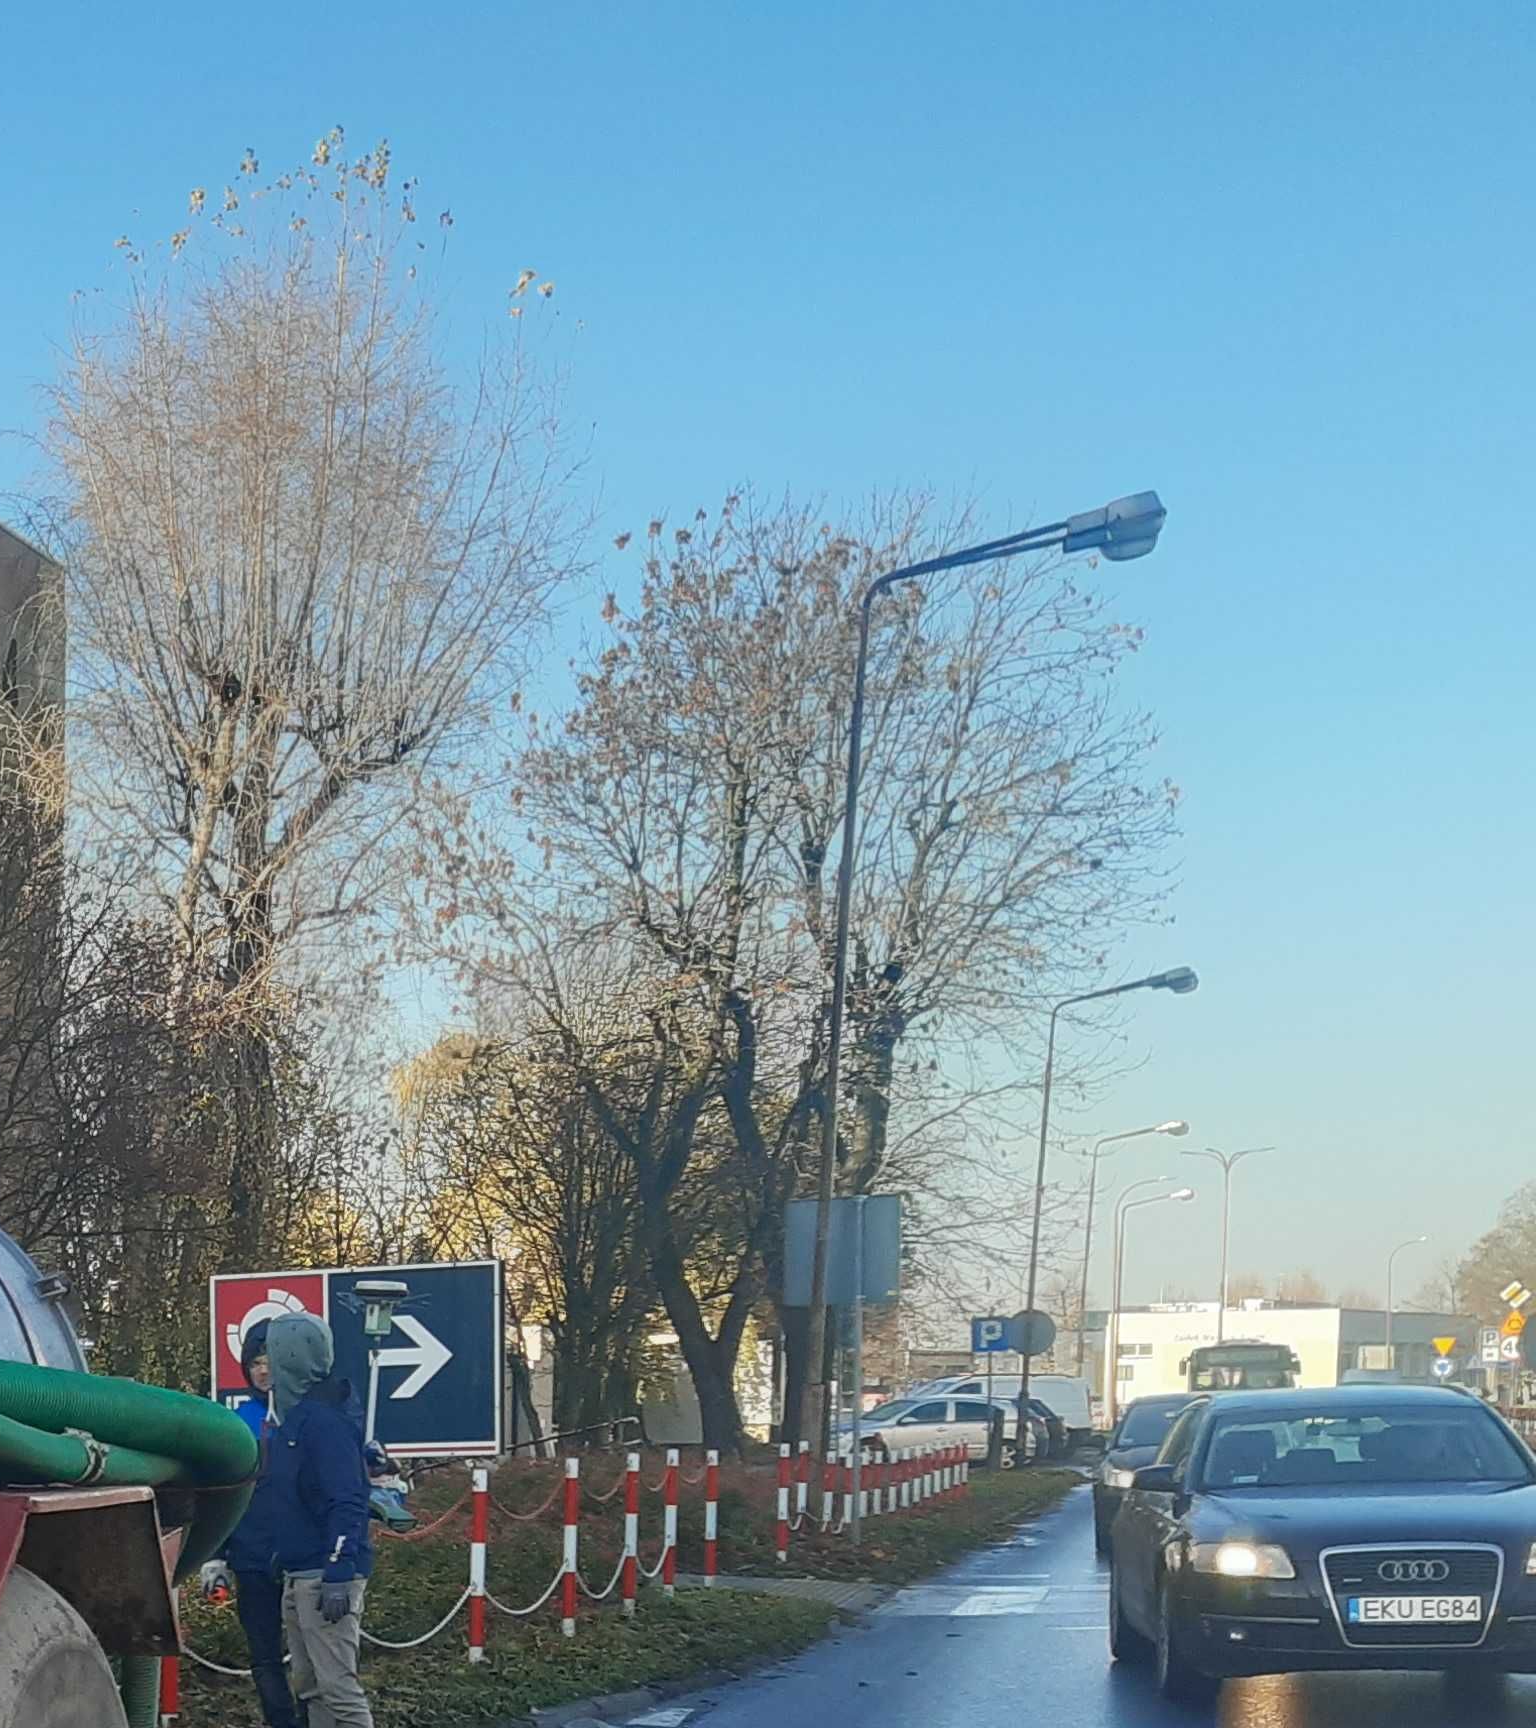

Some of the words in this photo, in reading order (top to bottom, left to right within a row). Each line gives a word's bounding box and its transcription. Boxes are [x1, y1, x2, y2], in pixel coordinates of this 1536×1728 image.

[979, 1320, 1003, 1349] P
[1363, 1599, 1414, 1620] EKU
[1421, 1599, 1479, 1619] EG84
